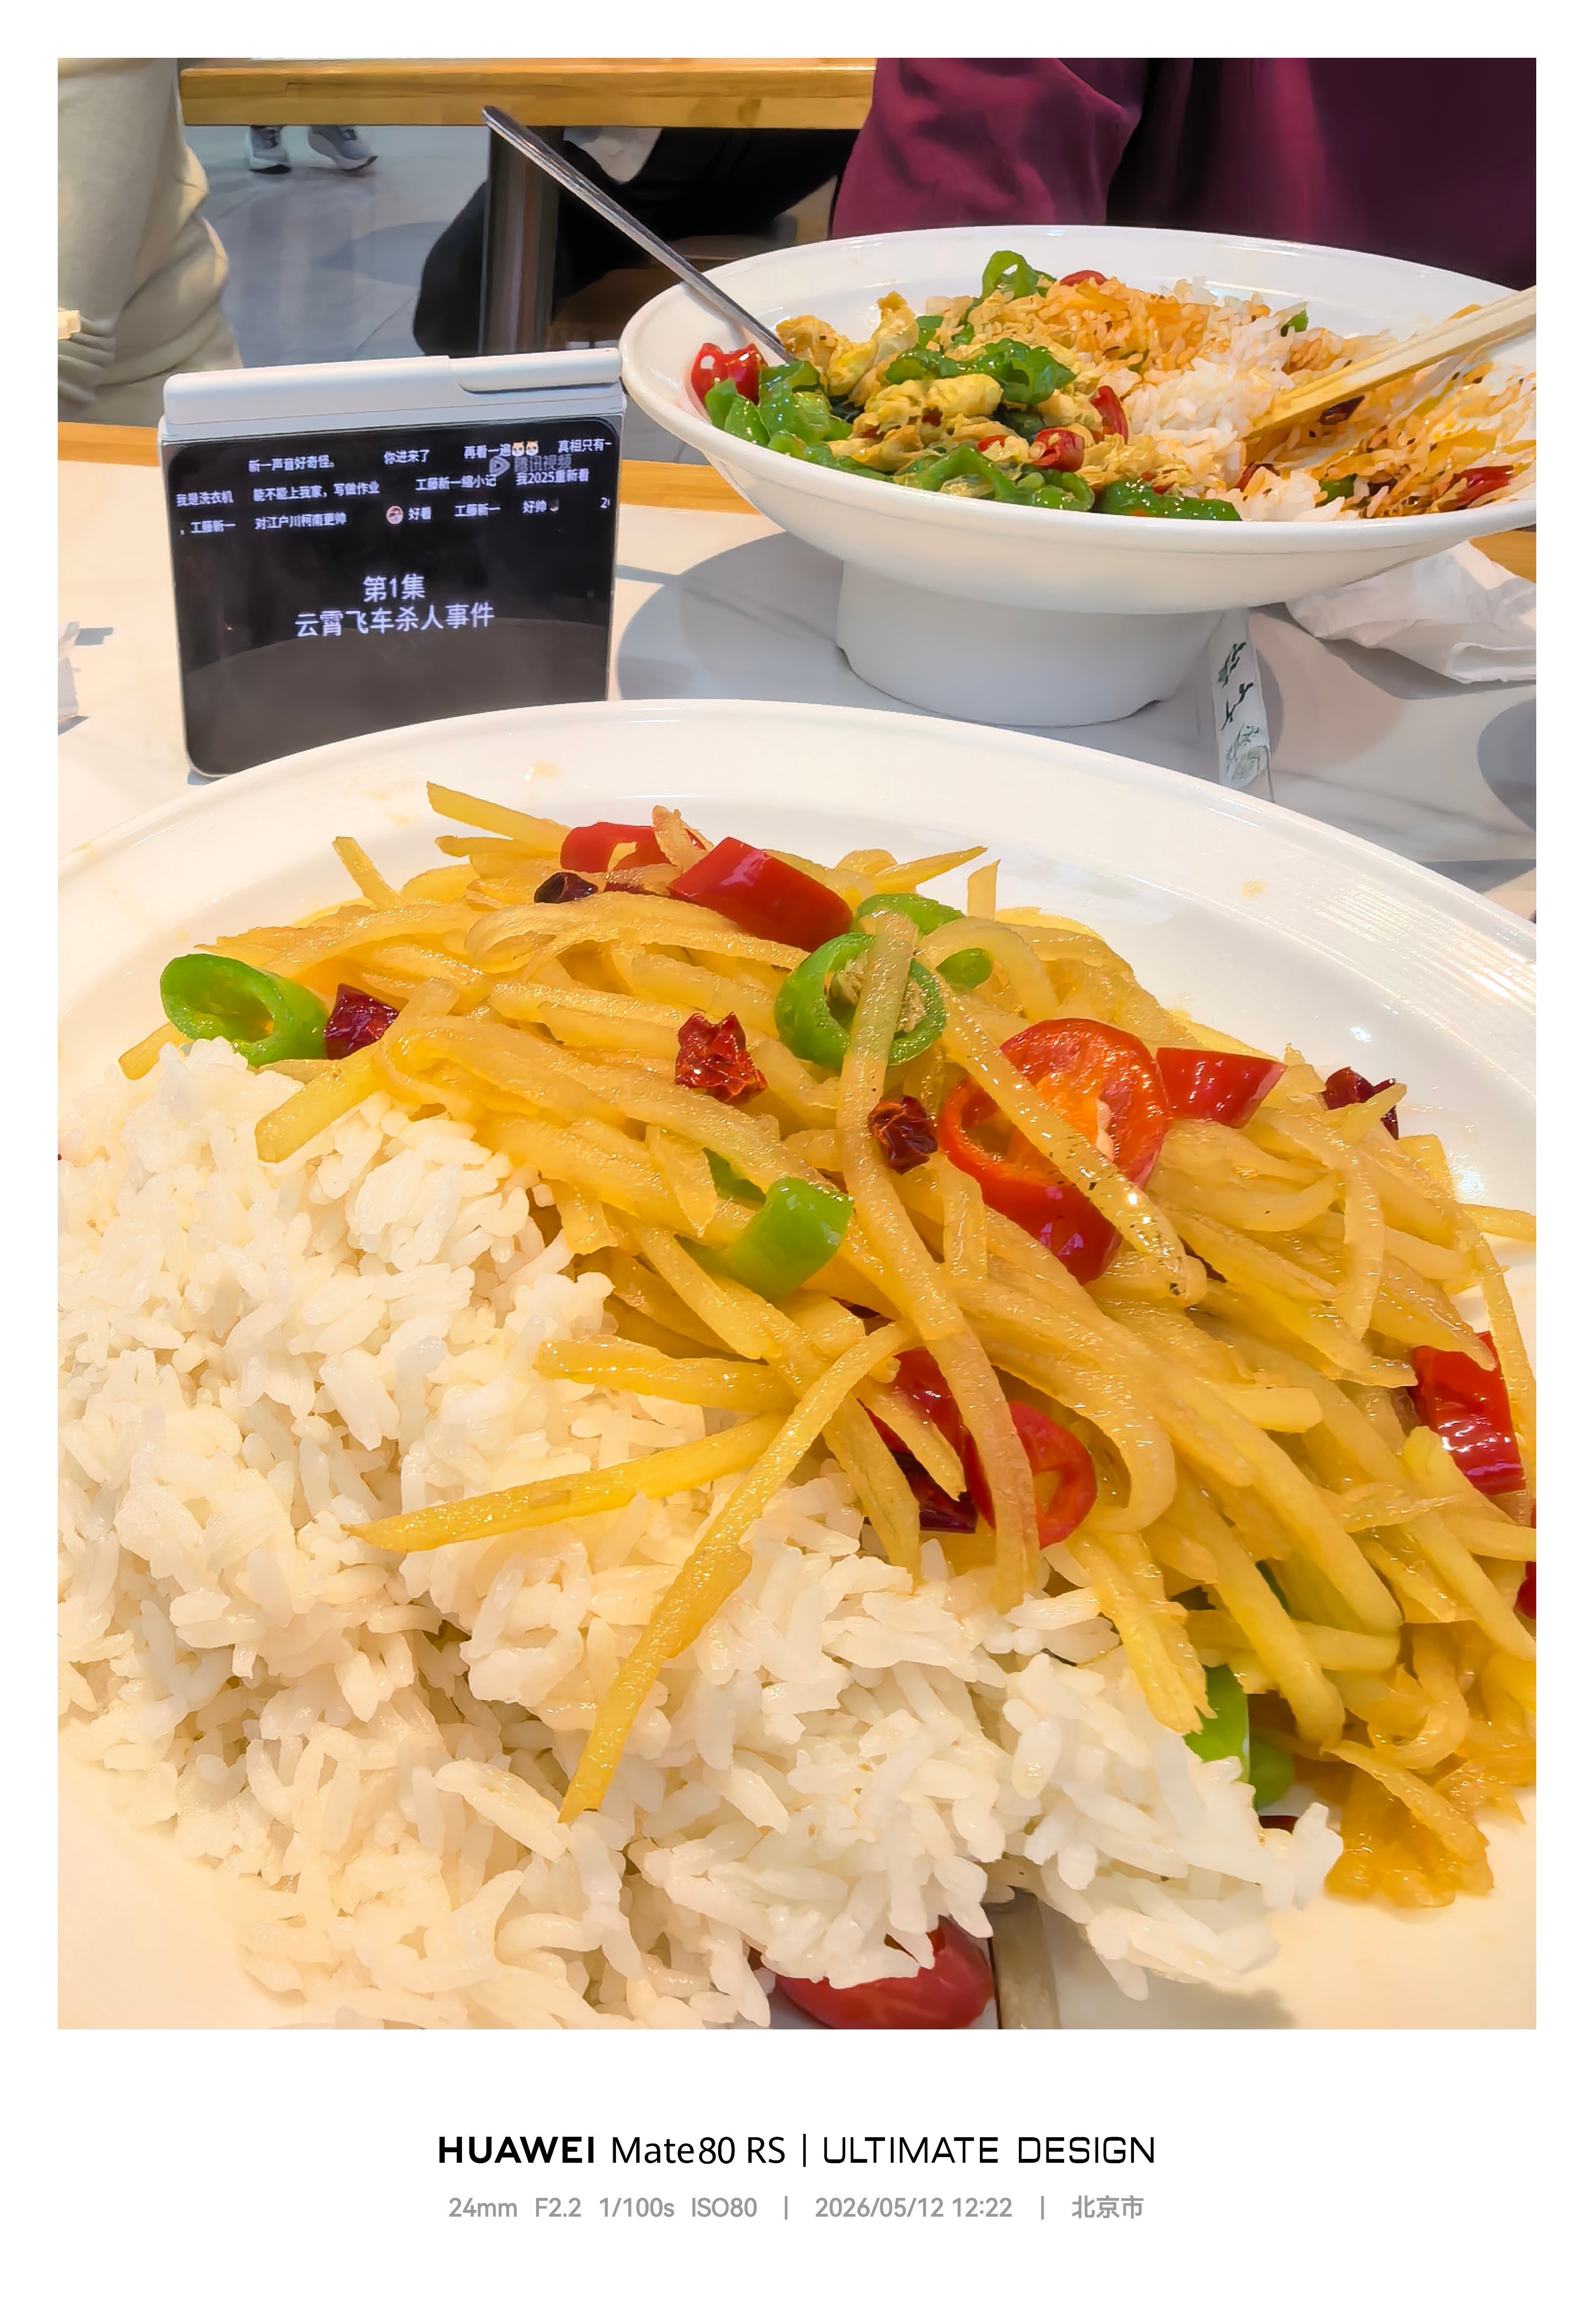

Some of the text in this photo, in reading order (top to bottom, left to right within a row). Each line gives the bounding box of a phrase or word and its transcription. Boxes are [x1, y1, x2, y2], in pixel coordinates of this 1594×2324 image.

[384, 449, 429, 465] 你进来了
[464, 443, 512, 459] 再看一遍
[514, 454, 572, 472] 腾讯视频
[516, 468, 589, 485] 我2025重新看
[176, 490, 234, 506] 我是洗衣机
[454, 503, 501, 517] 工藤新一
[255, 512, 347, 530] 对江户川柯南更帅
[363, 573, 425, 603] 第1集
[295, 601, 495, 637] 云霄飞车杀人事件
